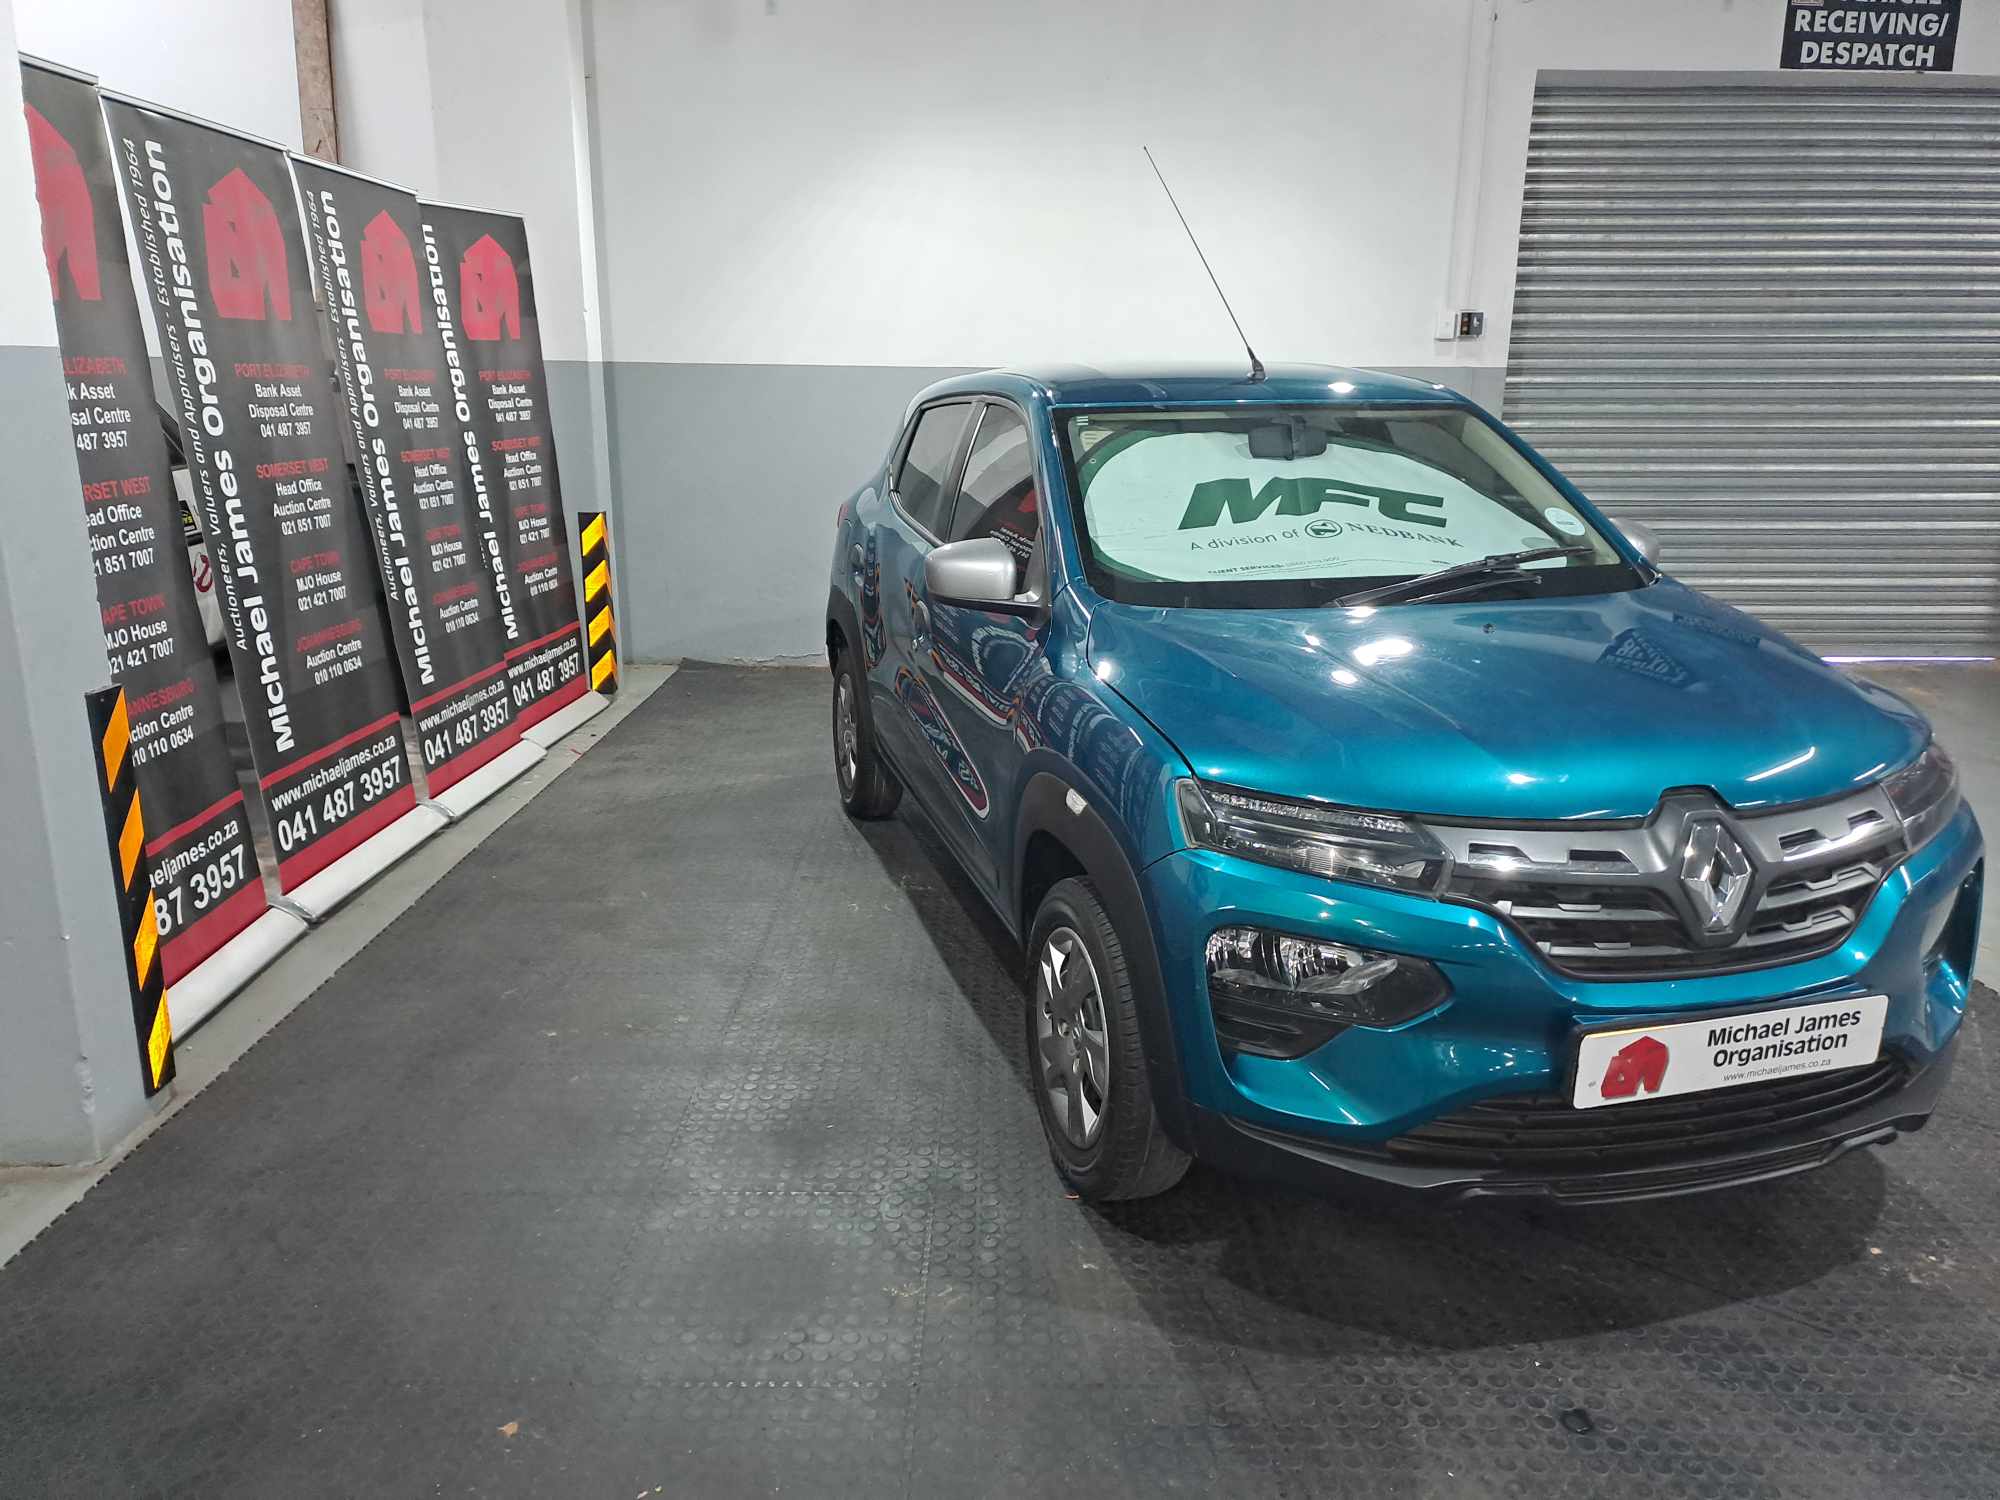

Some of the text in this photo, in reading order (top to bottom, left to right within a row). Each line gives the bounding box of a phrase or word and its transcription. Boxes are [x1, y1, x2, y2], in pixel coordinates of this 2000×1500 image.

[1794, 9, 1950, 37] RECEIVING/
[1800, 41, 1936, 67] DESPATCH
[123, 137, 144, 189] 1964
[306, 189, 321, 229] 1964
[135, 191, 171, 307] Established
[313, 230, 340, 322] Established
[421, 224, 471, 423] Organisation
[165, 322, 197, 424] Appraisers
[336, 336, 360, 418] Appraisers
[80, 382, 116, 400] Asset
[255, 383, 302, 398] Bank Asset
[94, 406, 132, 425] Centre
[248, 403, 314, 420] Disposal Centre
[76, 430, 128, 451] 487 3957
[145, 140, 295, 753] Michael James Organisation
[186, 426, 206, 464] and
[260, 423, 276, 438] 041
[277, 422, 292, 437] 487
[320, 190, 435, 686] Michael James Organisation
[352, 420, 366, 449] and
[121, 476, 151, 496] WEST
[275, 478, 323, 497] Head Office
[361, 453, 379, 508] Valuers
[463, 430, 493, 524] James
[107, 503, 142, 523] Office
[200, 470, 219, 536] Valuers
[273, 496, 332, 518] Auction Centre
[1177, 476, 1447, 530] MFC
[119, 527, 155, 546] Centre
[281, 520, 297, 536] 021
[1190, 521, 1465, 552] A division of NEDBANK
[104, 553, 126, 574] 851
[128, 548, 154, 568] 7007
[374, 513, 400, 601] Auctioneers,
[216, 543, 248, 650] Auctioneers,
[296, 570, 342, 593] MJO House
[483, 531, 519, 640] Michael
[298, 596, 312, 612] 021
[312, 592, 327, 607] 421
[130, 619, 168, 642] House
[126, 646, 148, 668] 421
[149, 637, 174, 660] 7007
[306, 638, 363, 669] Auction Centre
[314, 669, 329, 686] 010
[328, 663, 343, 678] 110
[512, 652, 579, 707] 041 487 3957
[160, 704, 194, 729] Centre
[418, 679, 505, 732] www.michaeljames.co.za
[147, 737, 168, 758] 110
[169, 725, 194, 749] 0634
[424, 696, 509, 765] 041 487 3957
[271, 735, 397, 812] www.michaeljames.co.za
[277, 754, 401, 852] 041 487 3957
[189, 843, 245, 909] 3957
[1707, 1010, 1861, 1047] Michael James
[1713, 1032, 1848, 1067] Organisation
[1722, 1058, 1831, 1081] www.michaeljames.co.za
